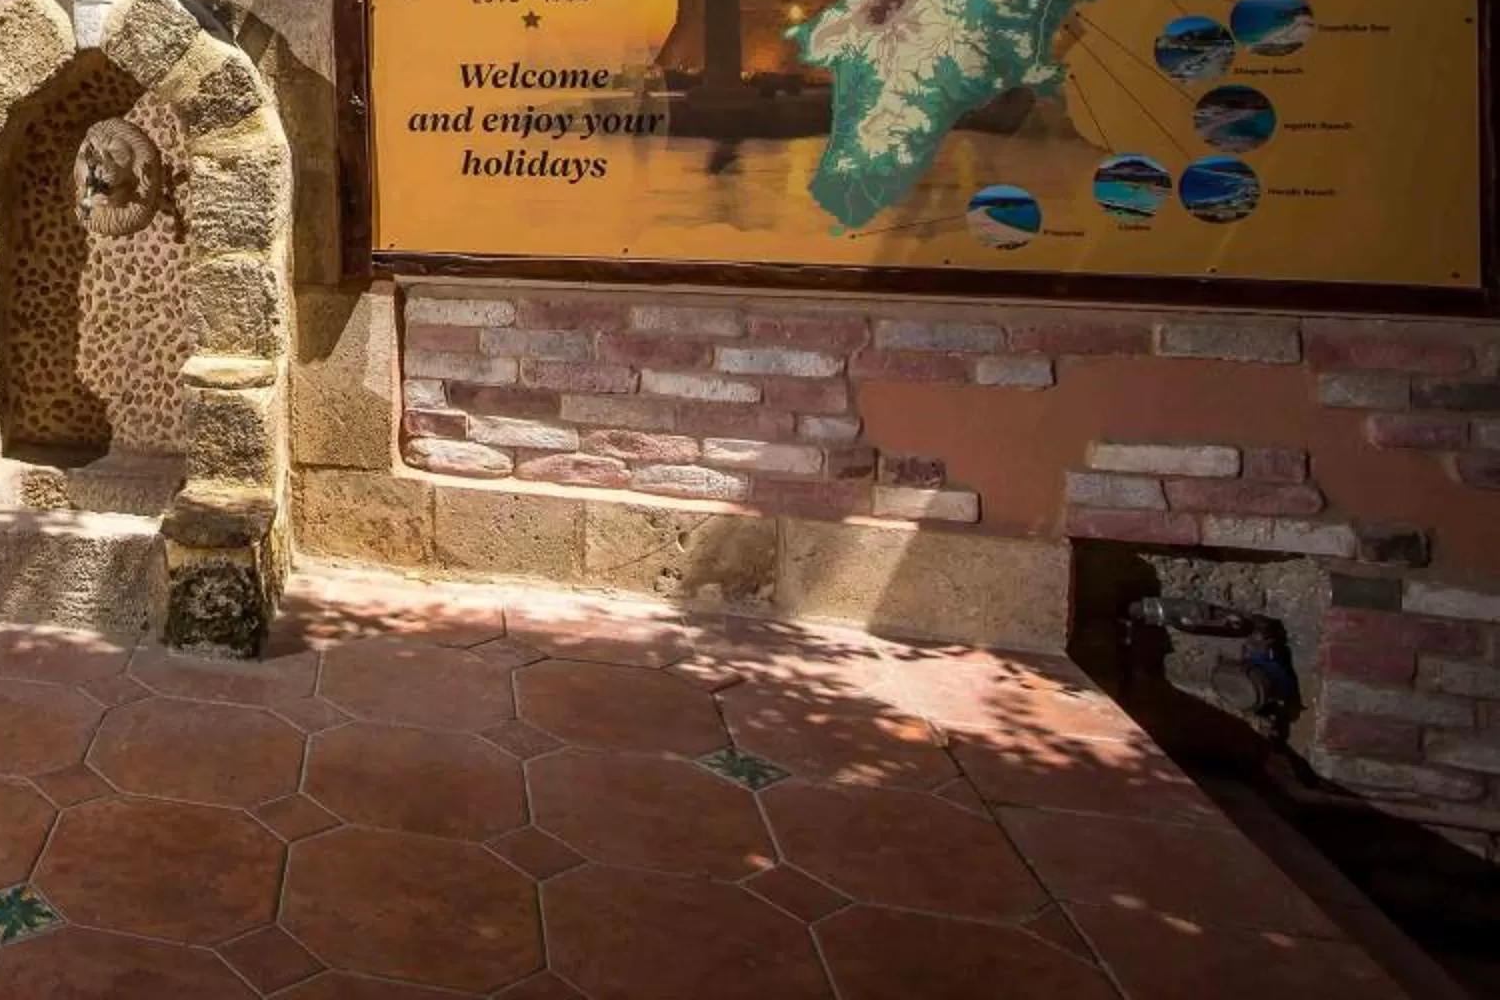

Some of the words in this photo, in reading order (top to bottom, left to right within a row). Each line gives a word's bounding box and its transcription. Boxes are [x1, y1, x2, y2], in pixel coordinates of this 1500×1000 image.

[460, 62, 609, 89] Welcome
[408, 106, 474, 133] and
[482, 106, 574, 139] enjoy
[580, 112, 665, 139] your
[461, 150, 608, 184] holidays
